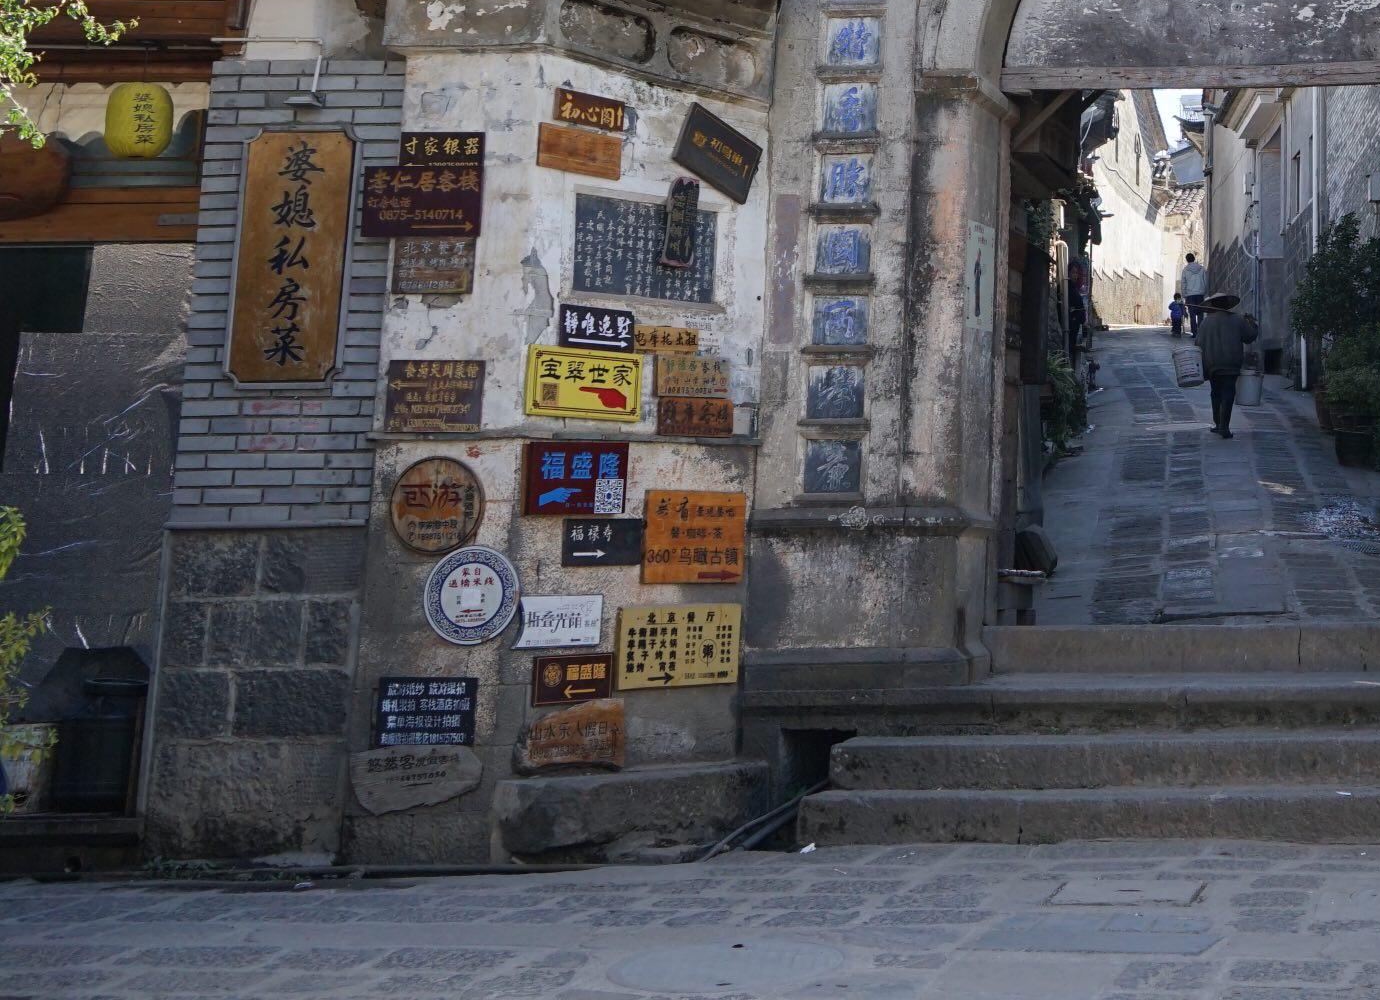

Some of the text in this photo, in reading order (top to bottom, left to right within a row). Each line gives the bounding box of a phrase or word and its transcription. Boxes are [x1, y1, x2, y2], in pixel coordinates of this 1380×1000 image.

[405, 136, 480, 156] 寸家银器
[540, 358, 633, 387] 宝翠世家
[540, 451, 621, 480] 福盛隆
[647, 611, 715, 624] 北京餐厅
[566, 663, 606, 681] 福盛隆
